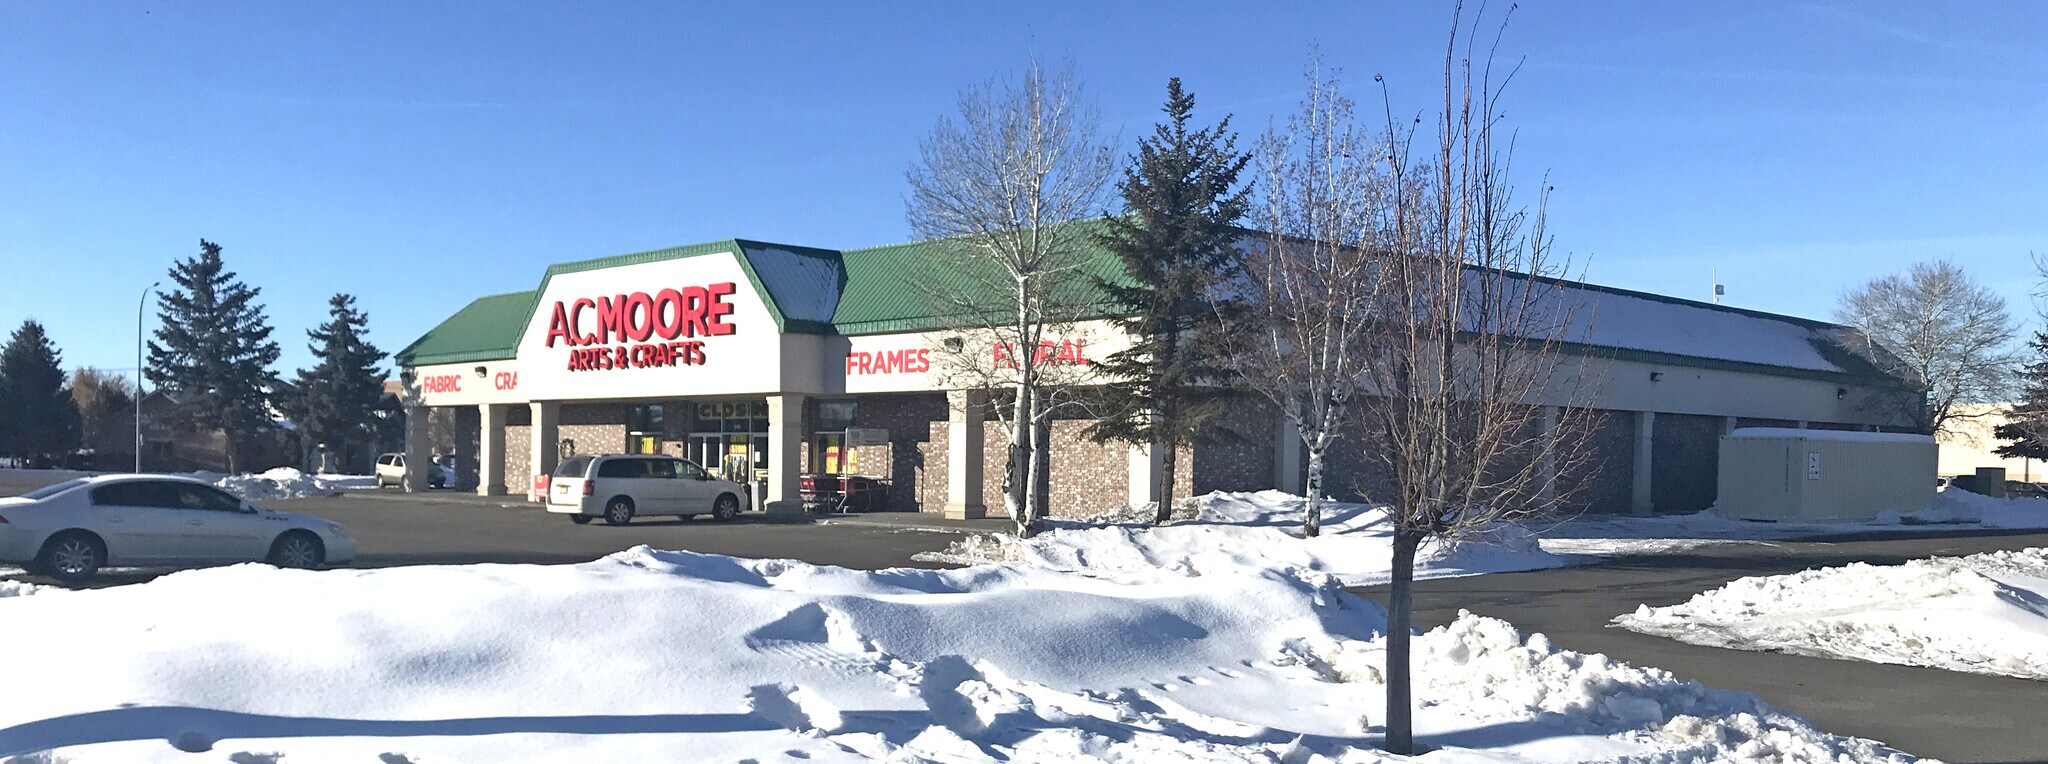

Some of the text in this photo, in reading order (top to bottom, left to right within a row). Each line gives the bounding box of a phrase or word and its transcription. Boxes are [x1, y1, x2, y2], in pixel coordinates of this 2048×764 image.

[567, 340, 706, 372] ARTS & CRAFTS
[846, 348, 930, 375] FRAMES
[423, 374, 462, 393] FABRIC
[699, 402, 766, 418] CLOSN
